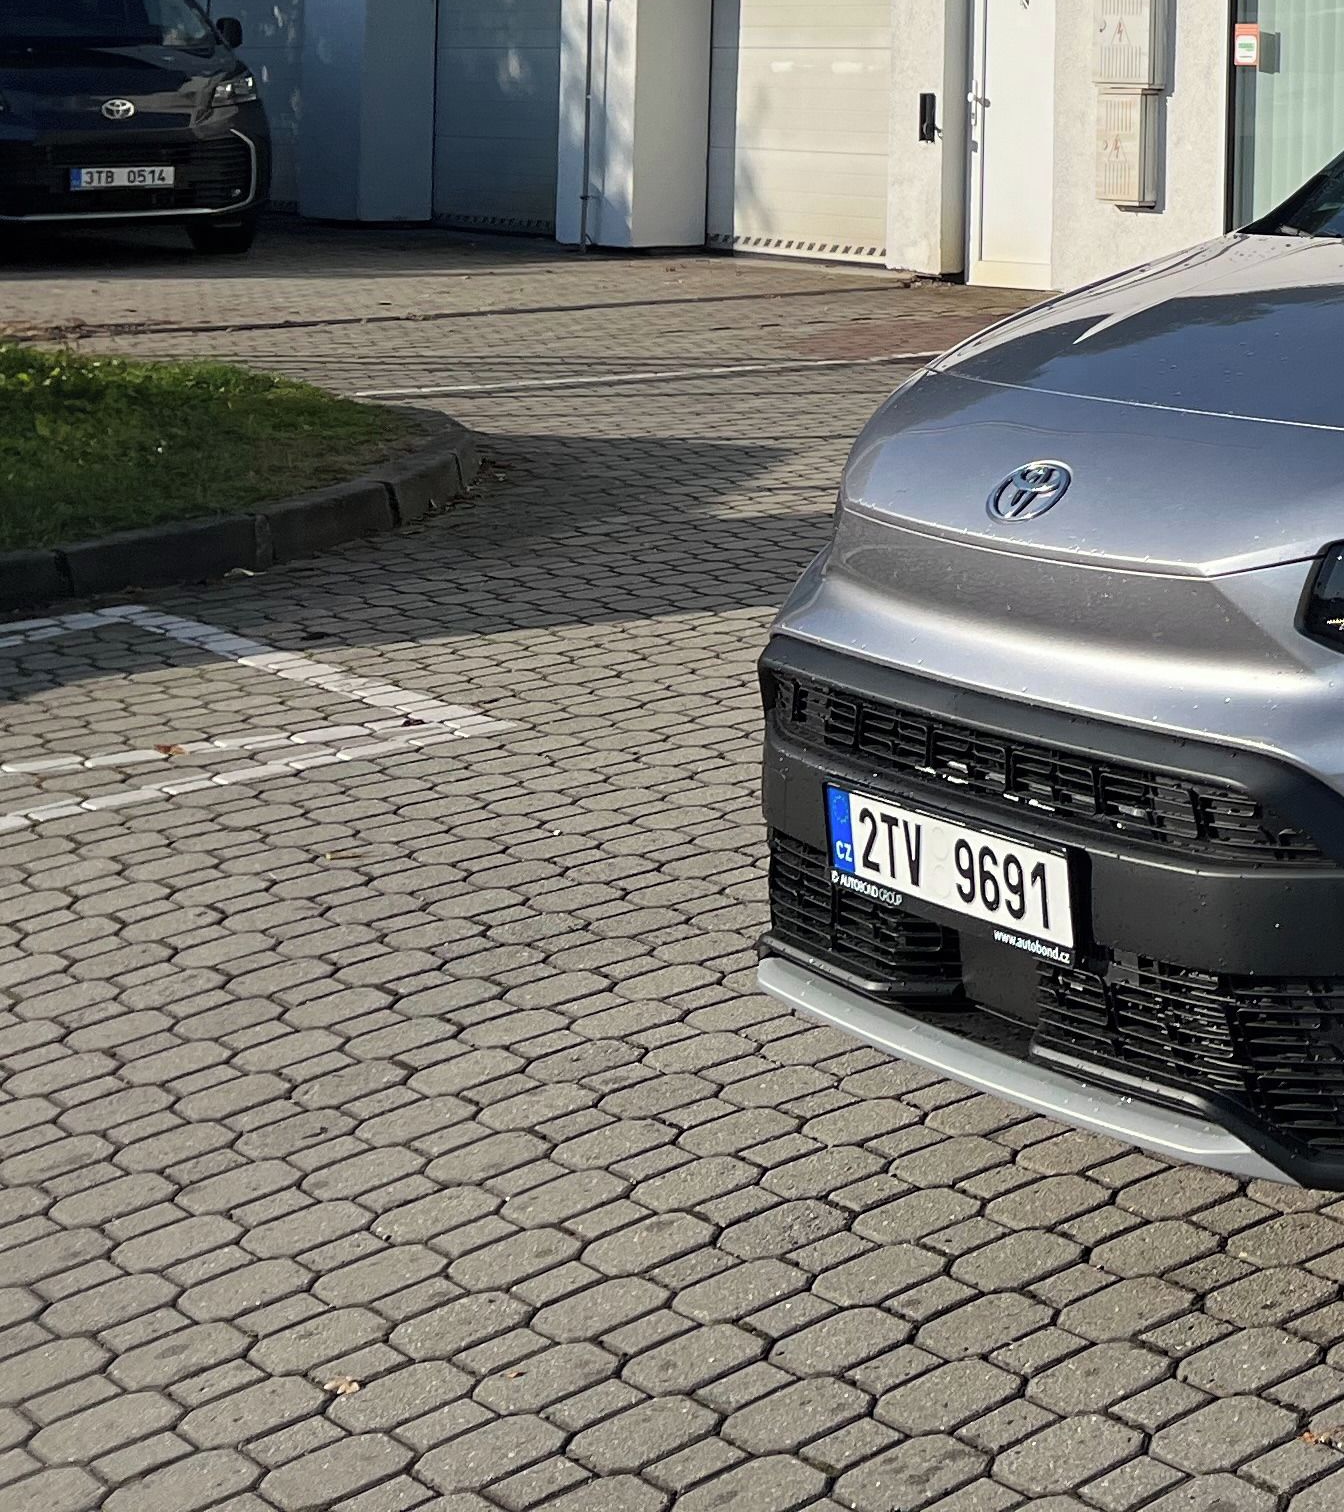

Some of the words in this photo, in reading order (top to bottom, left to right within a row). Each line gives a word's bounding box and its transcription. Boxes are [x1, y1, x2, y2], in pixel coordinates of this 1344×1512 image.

[84, 170, 114, 185] 3TB
[127, 169, 166, 184] 0514
[835, 840, 853, 863] CZ
[858, 807, 922, 888] 2TV
[954, 838, 1050, 930] 9691
[993, 929, 1070, 964] www.autobond.cz
